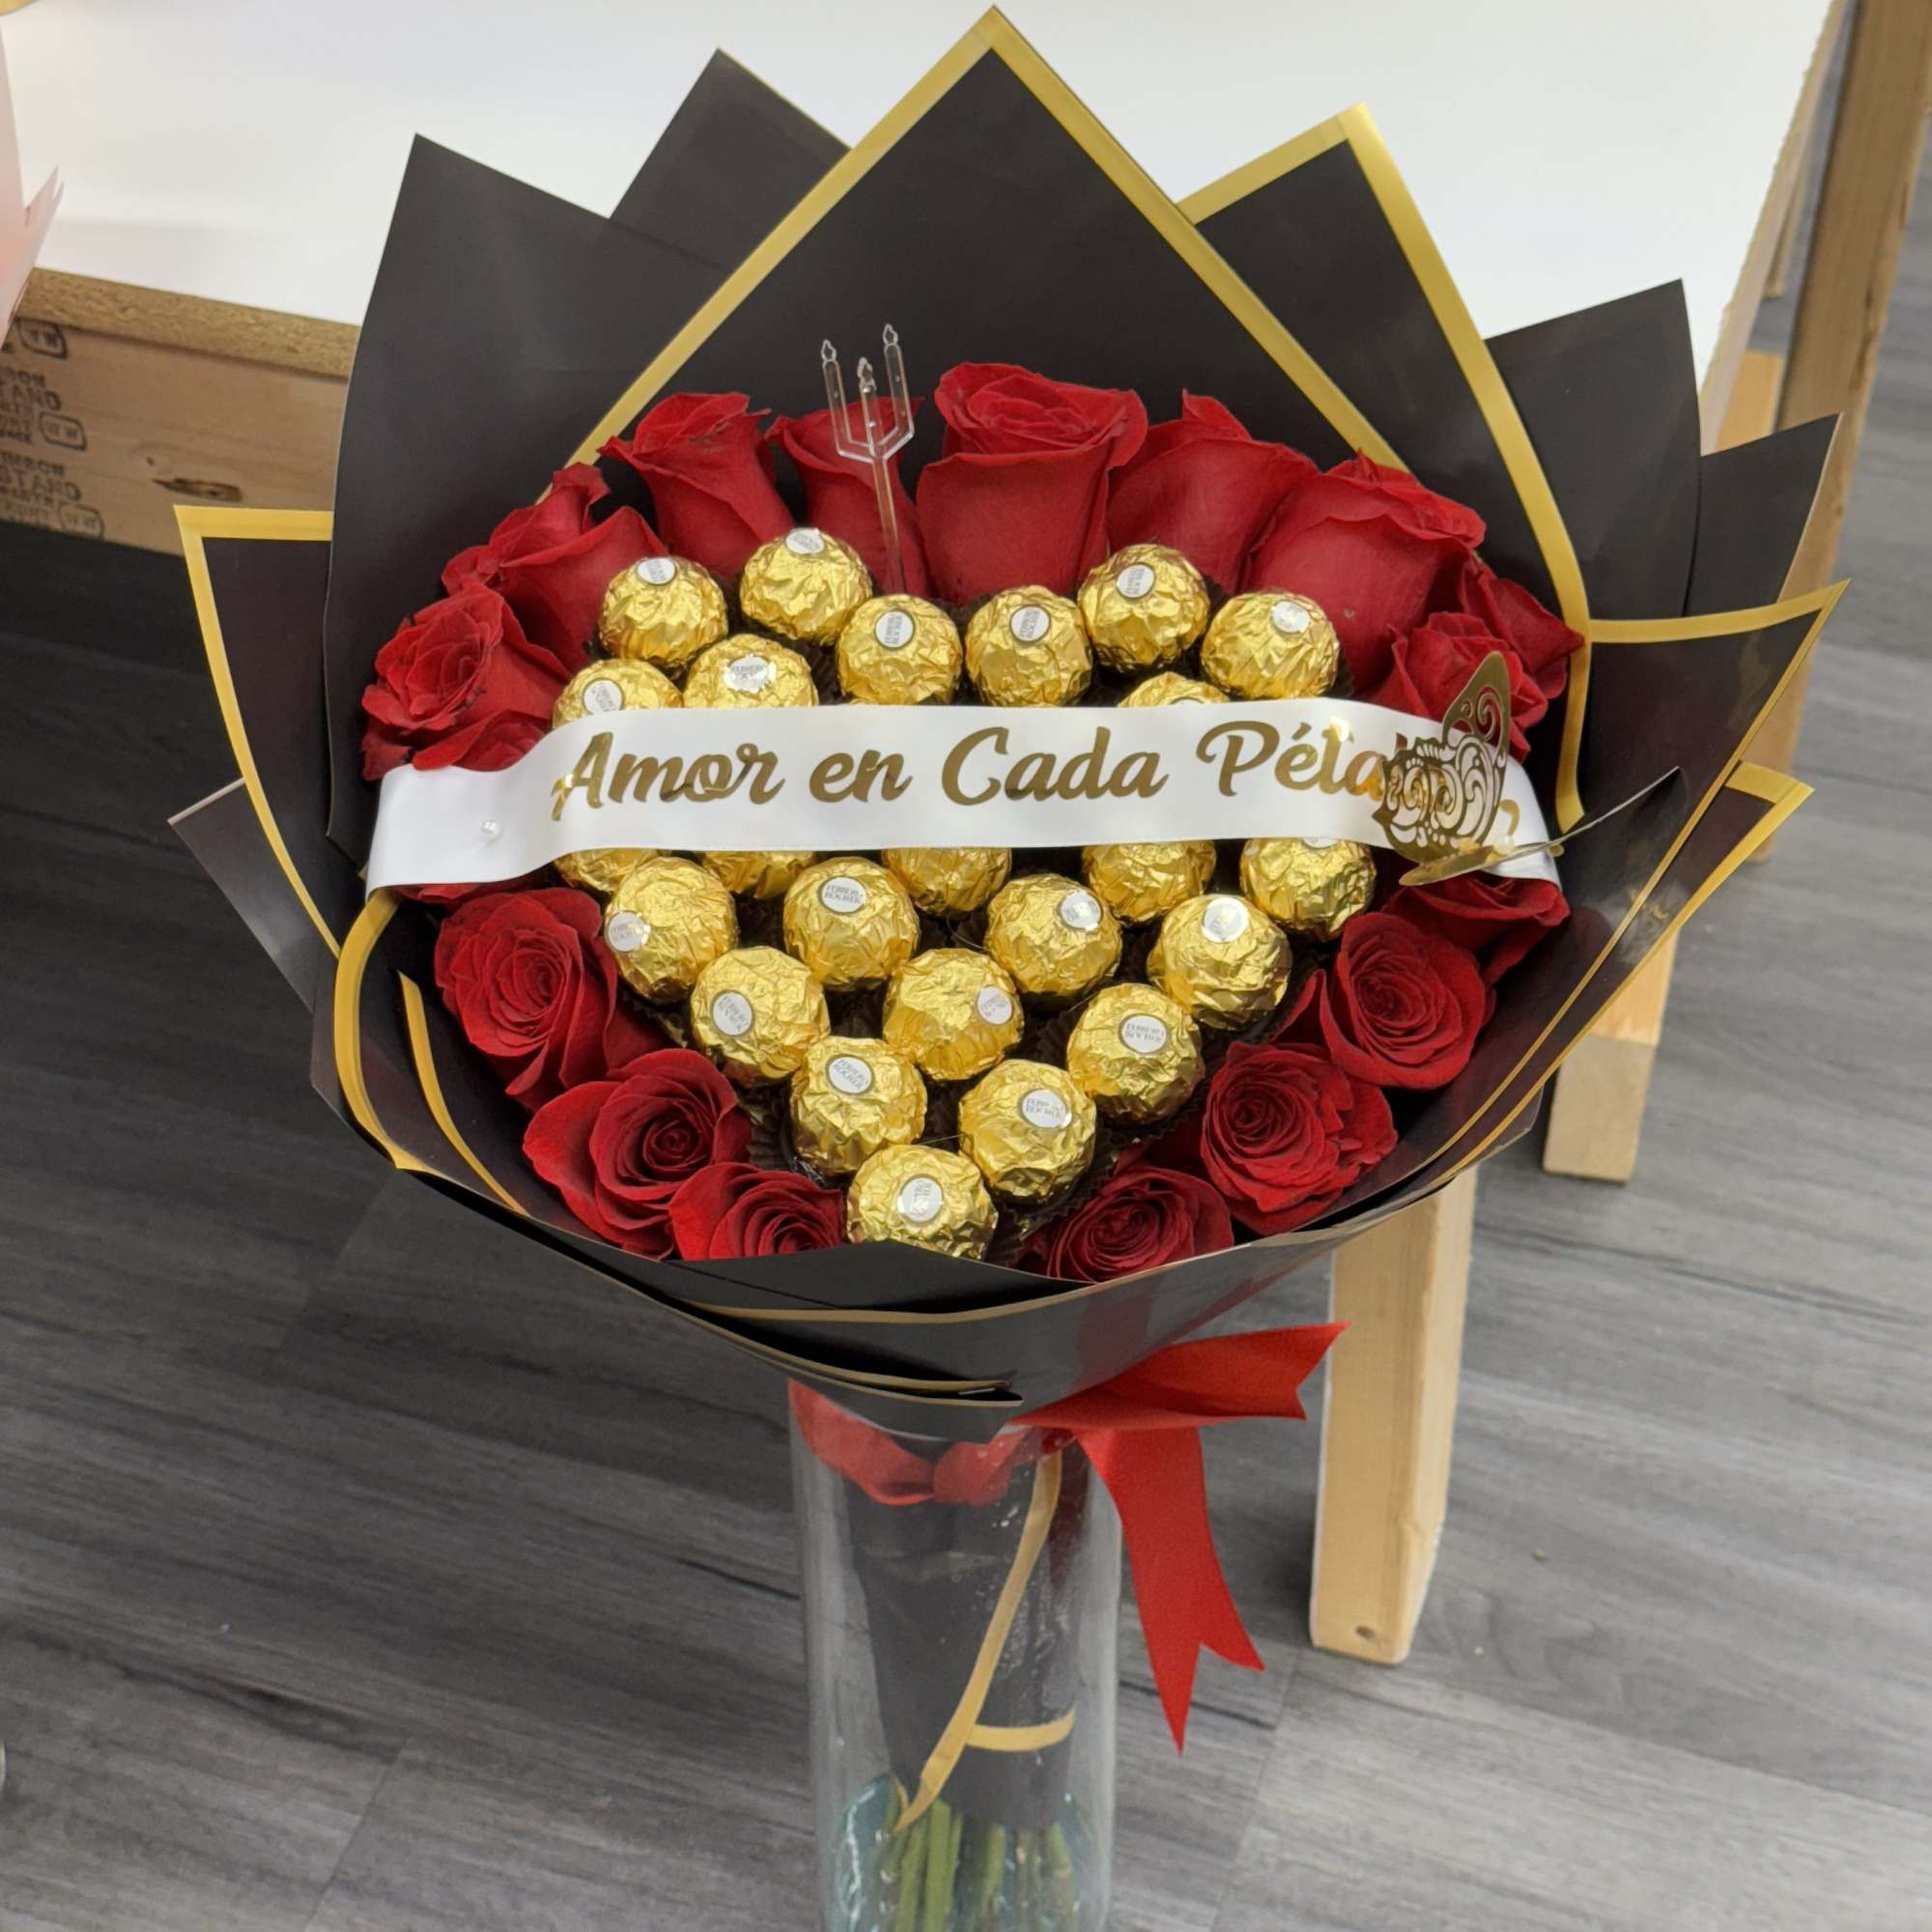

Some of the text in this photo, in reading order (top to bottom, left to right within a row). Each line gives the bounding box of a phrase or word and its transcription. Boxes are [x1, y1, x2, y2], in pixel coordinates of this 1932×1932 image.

[550, 731, 785, 820] Amor
[810, 750, 913, 804] en
[942, 726, 1169, 807] Cada
